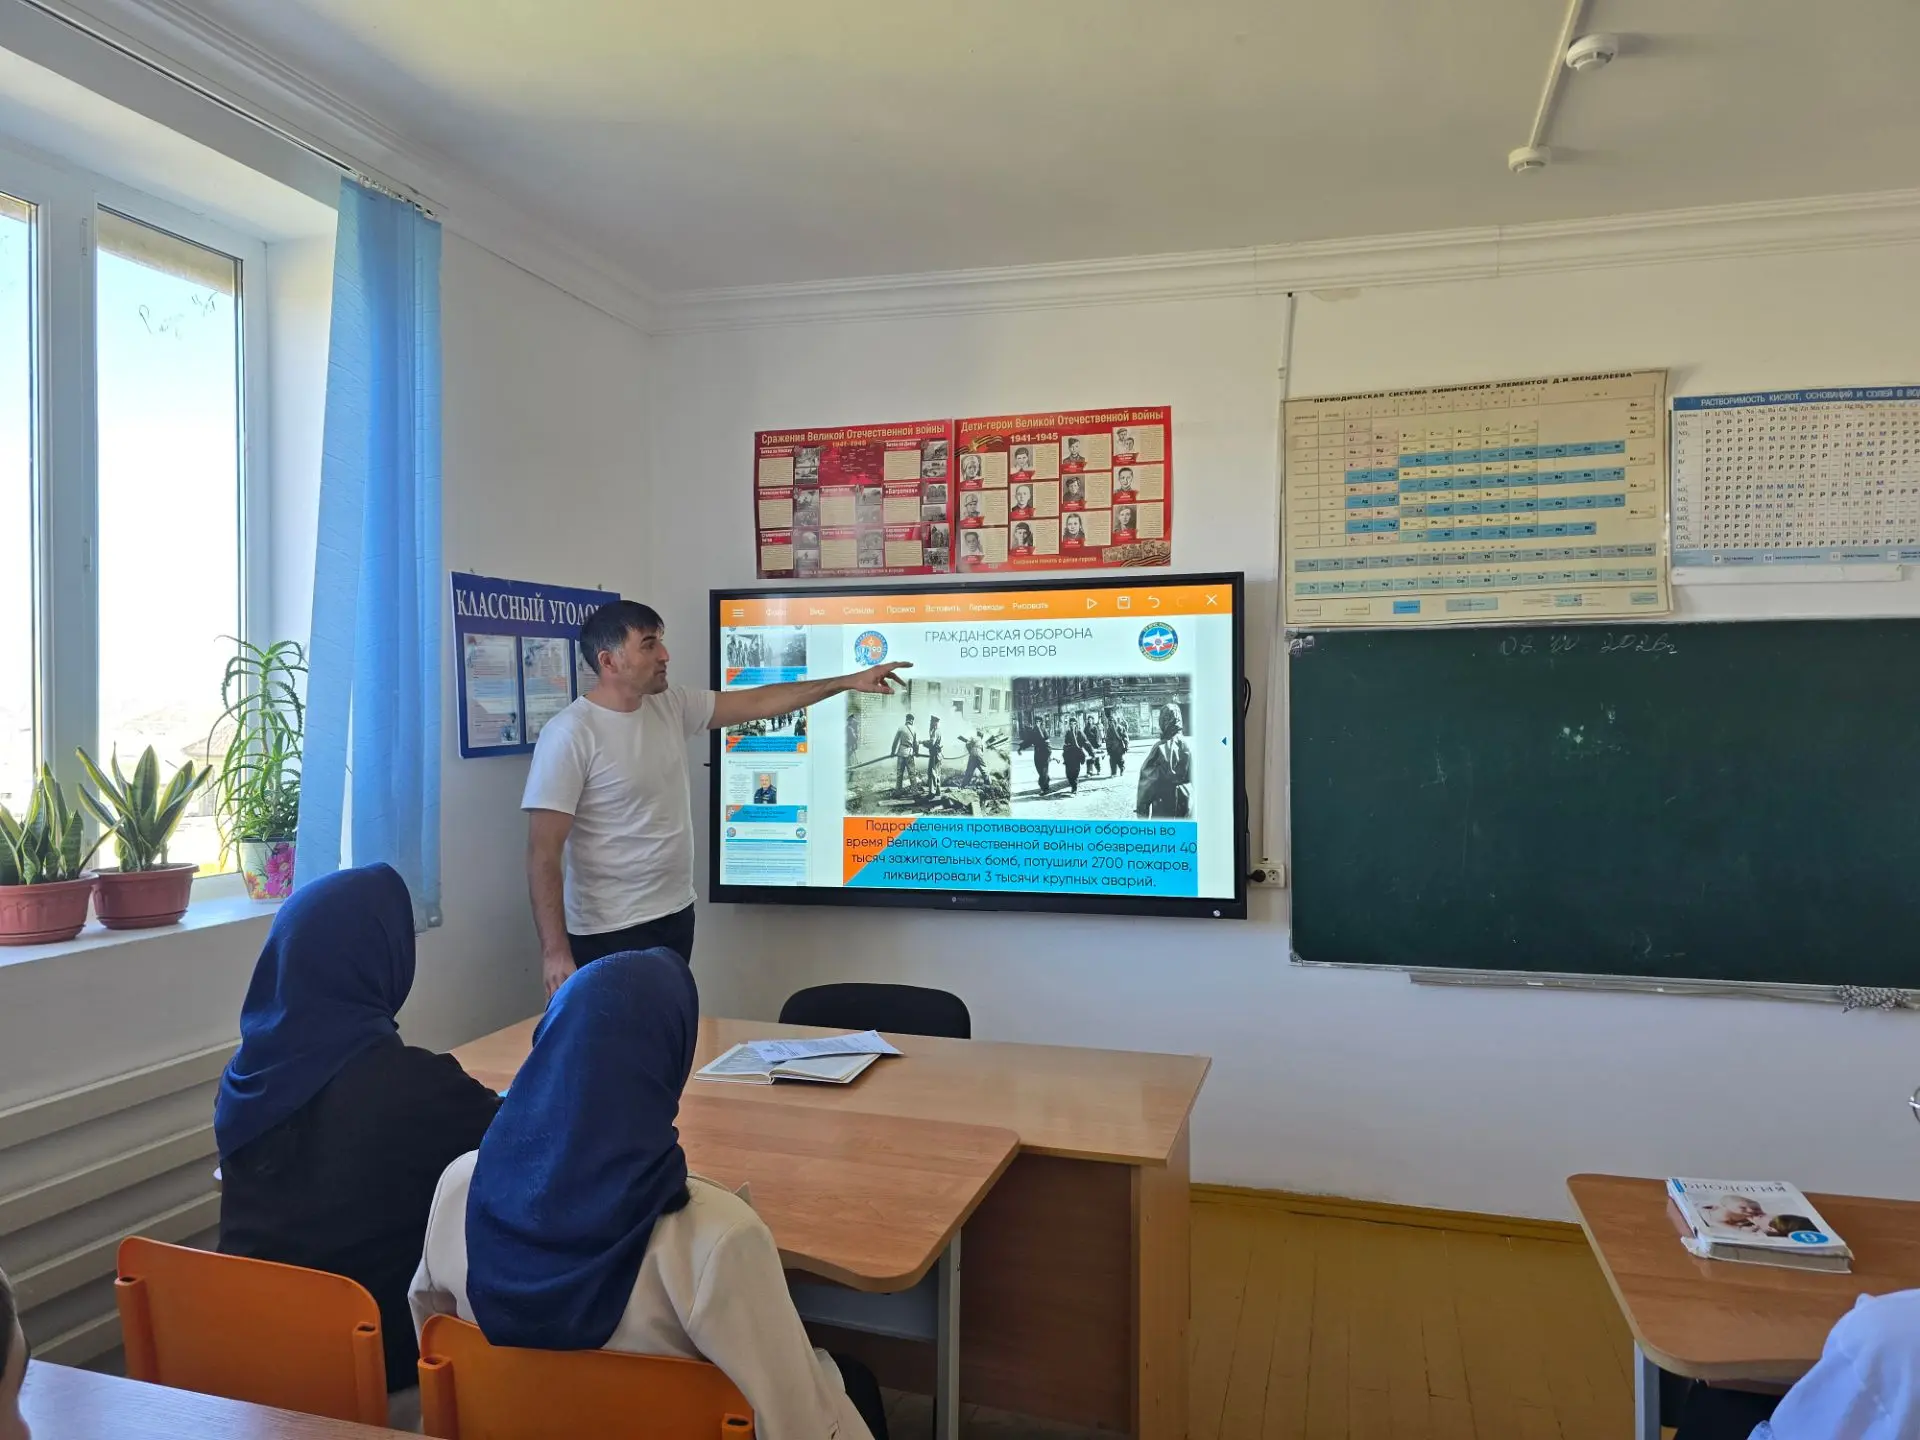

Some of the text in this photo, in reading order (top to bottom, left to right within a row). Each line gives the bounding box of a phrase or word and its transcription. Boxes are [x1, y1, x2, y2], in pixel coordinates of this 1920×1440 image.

[1314, 393, 1384, 403] ПЕРИОДИЧЕСКАЯ
[1388, 389, 1428, 398] СИСТЕМА
[1432, 384, 1491, 394] ХИМИЧЕСКИХ
[1495, 379, 1548, 389] ЭЛЕМЕНТОВ
[1701, 395, 1765, 406] РАСТВОРИМОСТЬ
[1769, 392, 1802, 402] КИСЛОТ,
[961, 410, 1164, 434] Дети-герои Великой Отечественной войны
[762, 424, 945, 445] Сражения Великой Отечественной войны
[456, 589, 545, 622] КЛАССНЫЙ
[1012, 602, 1049, 611] Рисовать
[925, 628, 1094, 643] ГРАЖДАНСКАЯ ОБОРОНА
[960, 645, 1057, 658] ВО ВРЕМЯ ВОВ
[866, 820, 1176, 837] Подразделения противовоздушной обороны во
[846, 836, 1197, 855] время Великой Отечественной войны обезвредили 40
[852, 854, 1192, 873] тысяч зажигательных бомб, потушили 2700 пожаров,
[883, 871, 1156, 888] ликвидировали 3 тысячи крупных аварий.
